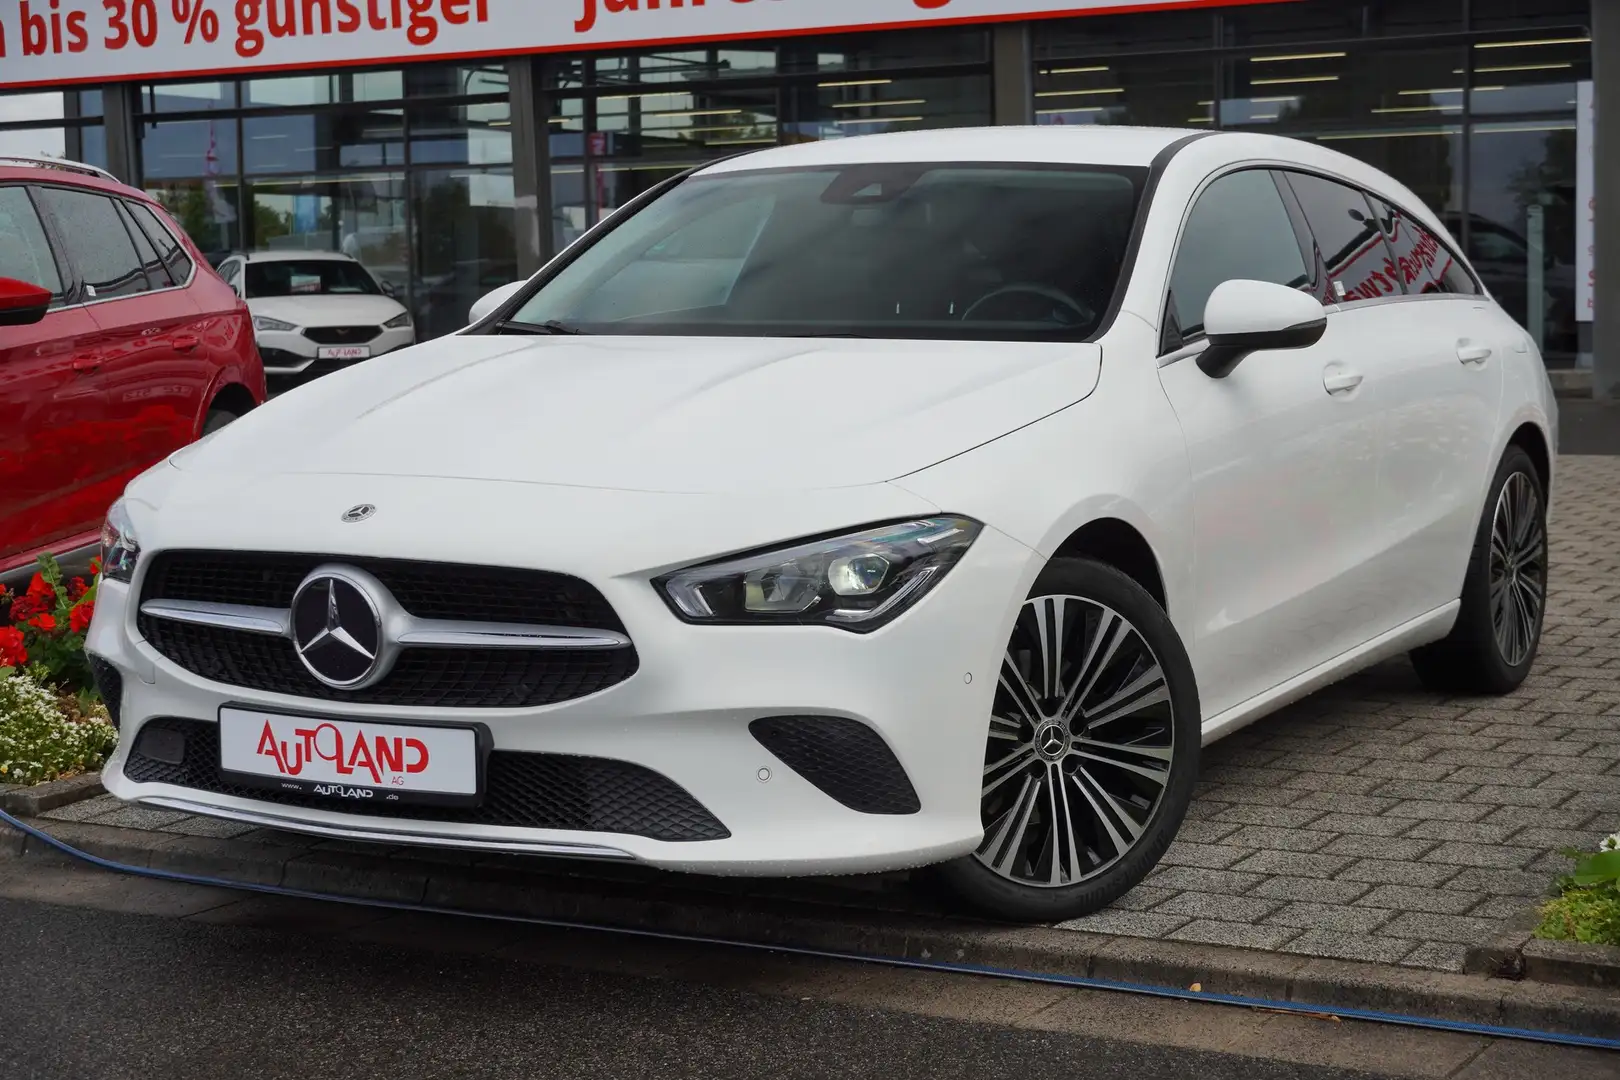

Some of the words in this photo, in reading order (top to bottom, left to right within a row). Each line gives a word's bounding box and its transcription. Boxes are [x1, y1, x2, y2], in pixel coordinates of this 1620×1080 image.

[20, 0, 88, 56] bis
[103, 0, 158, 50] 30
[172, 0, 219, 45] %
[256, 719, 429, 784] AUTOLAND
[281, 782, 302, 790] www.
[313, 784, 374, 798] AUTOLAND
[391, 776, 404, 785] AG
